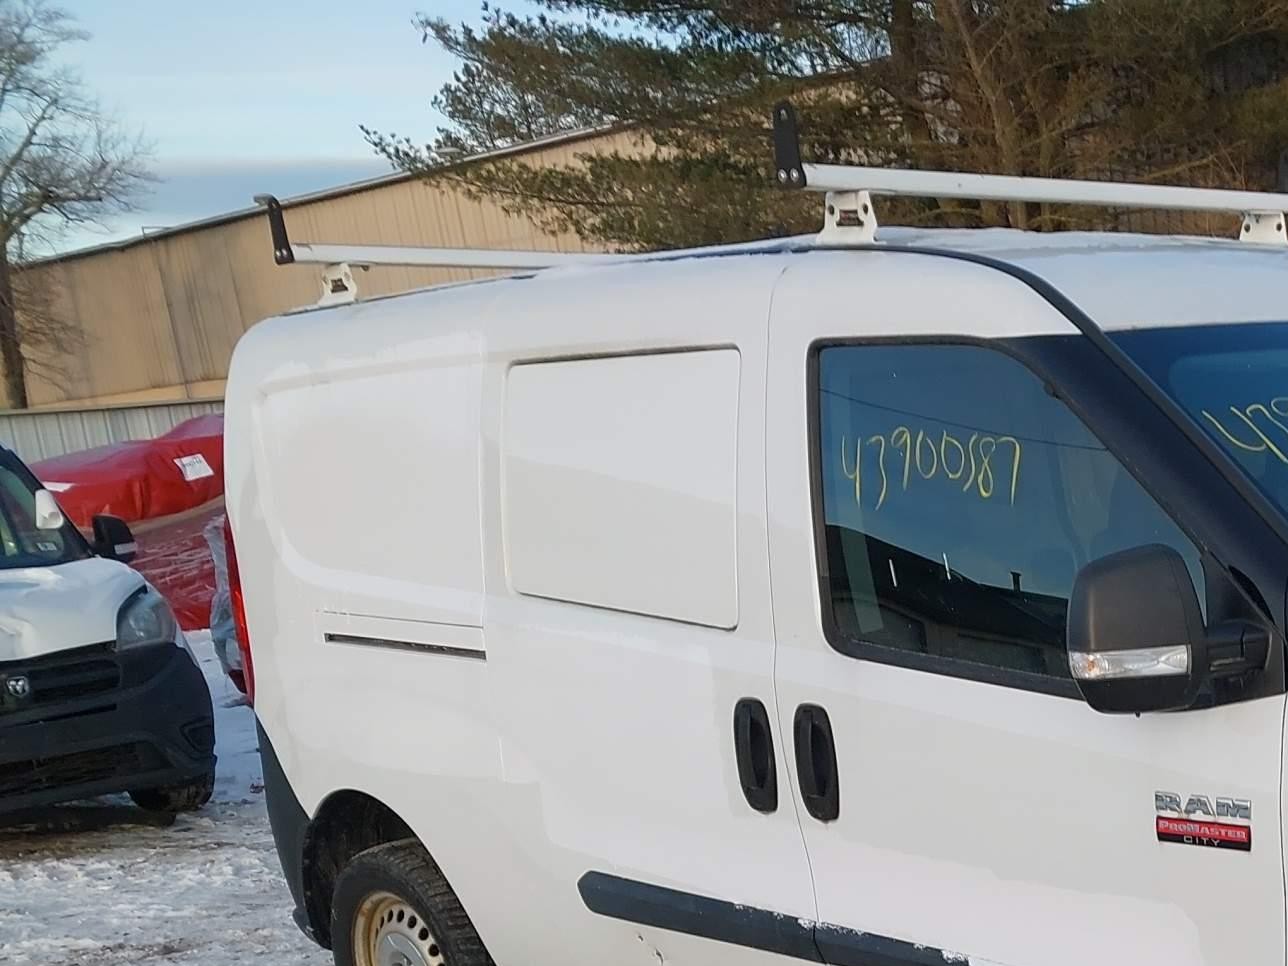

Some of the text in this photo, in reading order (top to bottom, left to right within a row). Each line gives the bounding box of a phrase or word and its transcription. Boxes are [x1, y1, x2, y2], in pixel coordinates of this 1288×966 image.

[840, 426, 1022, 511] 43900587
[1154, 790, 1252, 820] RAM
[1183, 834, 1220, 847] CITY
